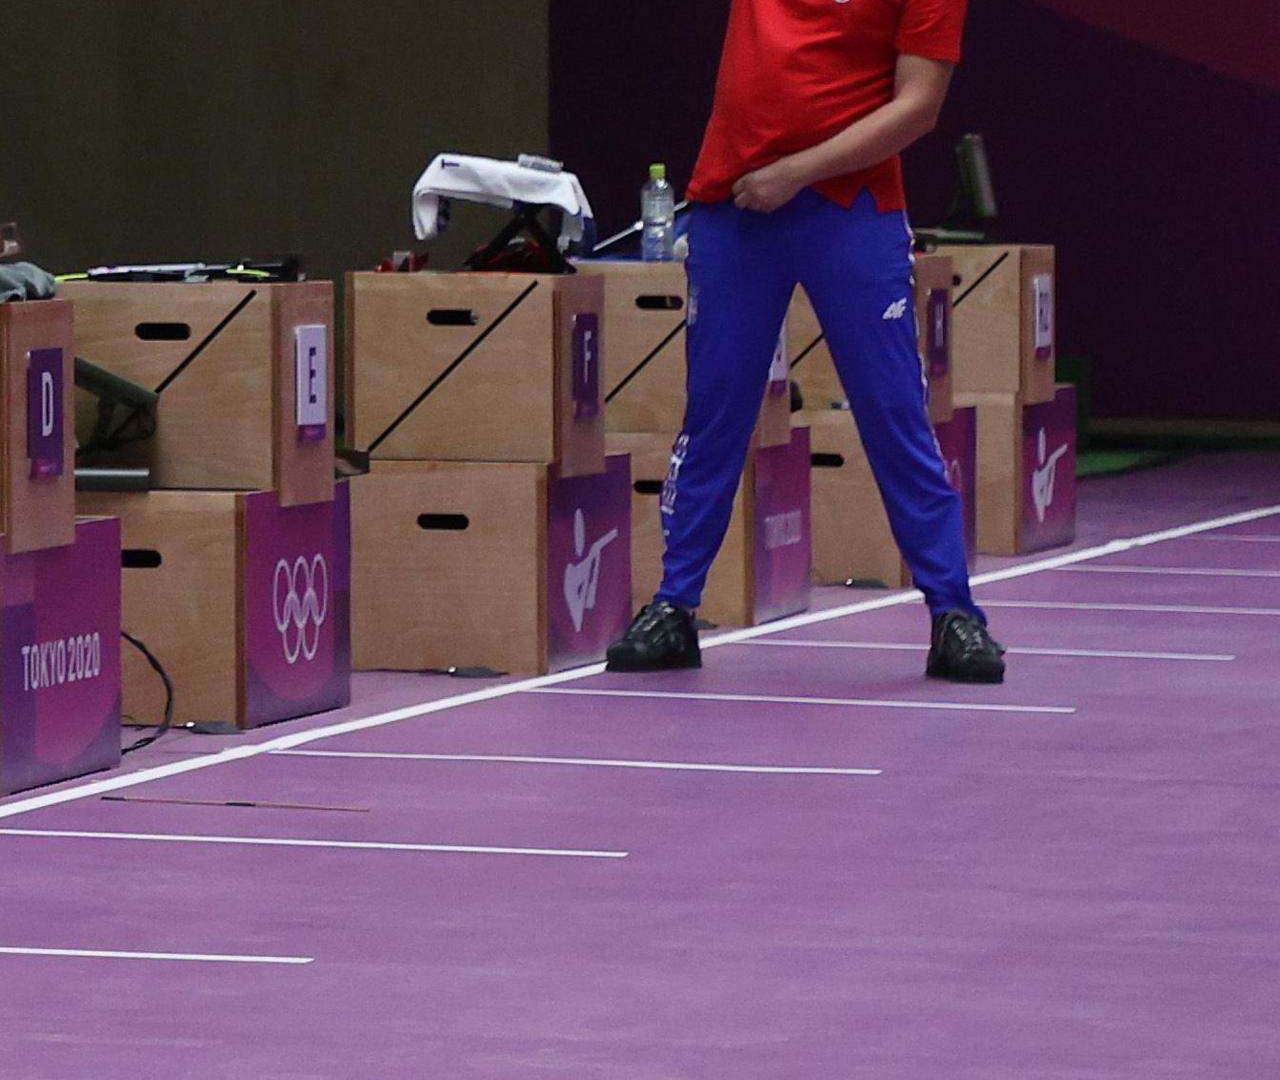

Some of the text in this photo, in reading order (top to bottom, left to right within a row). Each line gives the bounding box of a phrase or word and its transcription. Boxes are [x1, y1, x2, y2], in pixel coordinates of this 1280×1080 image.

[308, 347, 317, 404] E
[584, 330, 592, 383] F
[41, 370, 55, 438] D
[20, 631, 101, 692] TOKYO 2020
